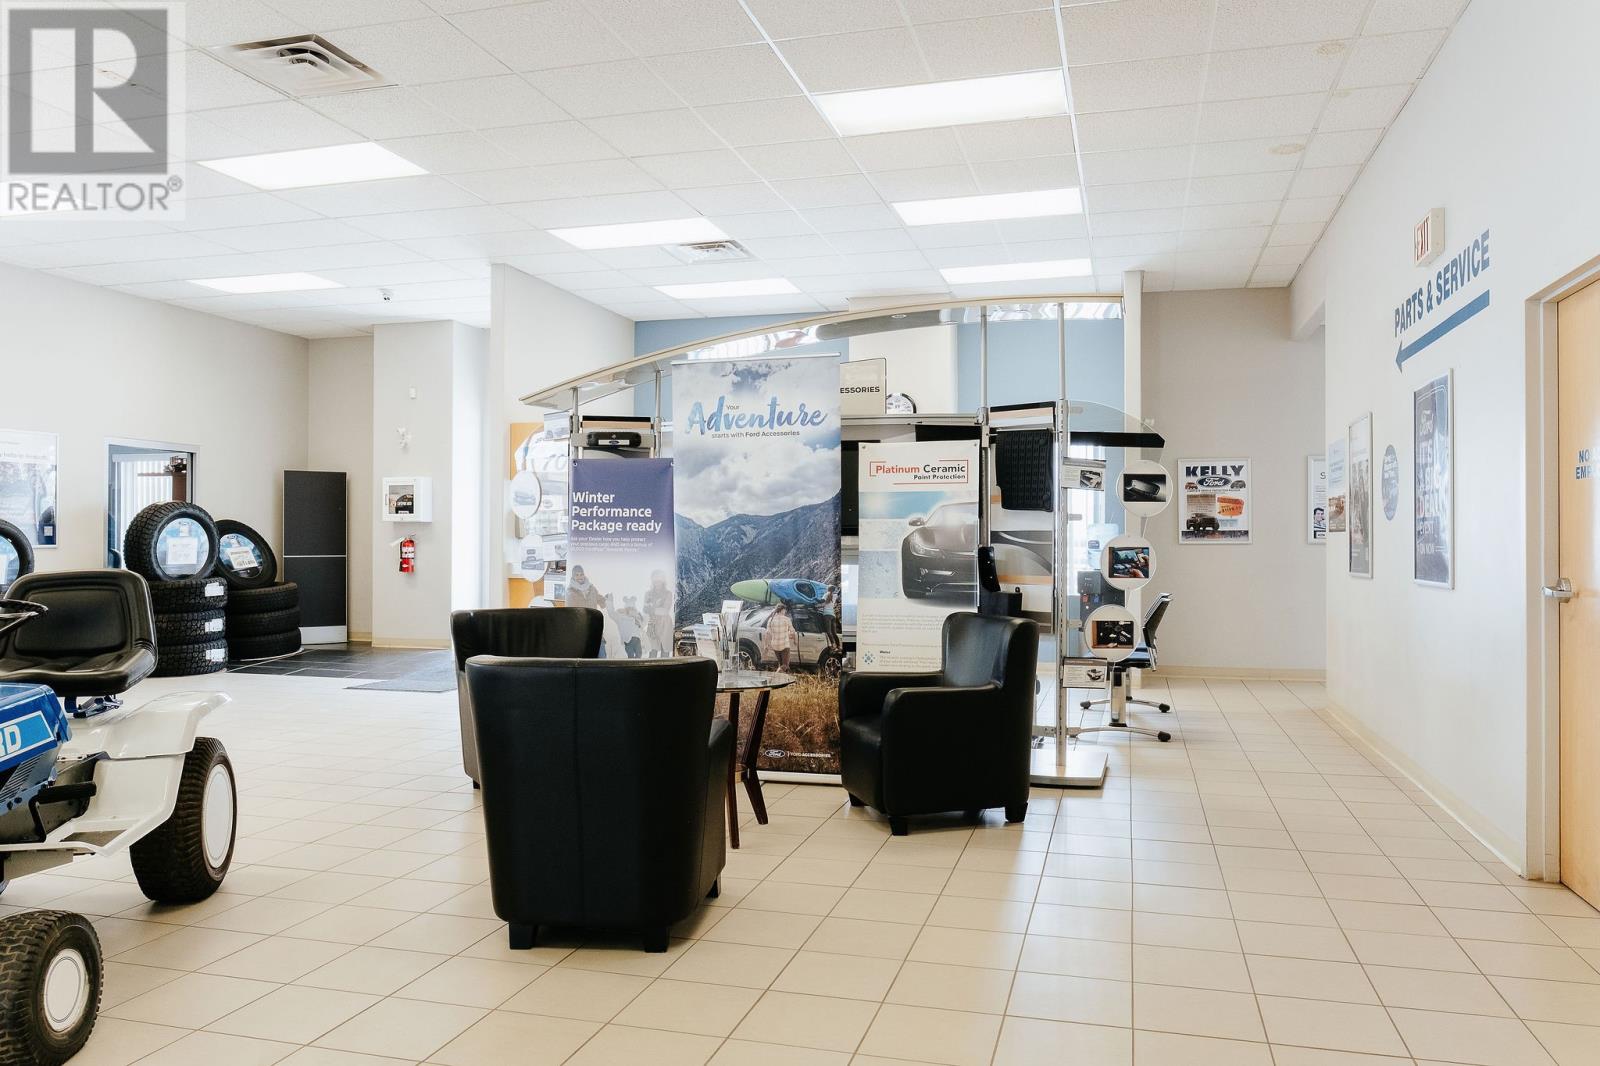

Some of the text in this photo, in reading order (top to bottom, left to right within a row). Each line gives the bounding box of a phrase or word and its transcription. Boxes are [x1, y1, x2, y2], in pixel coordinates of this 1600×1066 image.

[1416, 216, 1430, 261] EXIT
[1394, 228, 1490, 338] PARTS & SERVICE
[685, 395, 829, 436] Adventure
[875, 464, 966, 475] Platinum Ceramic
[1185, 465, 1244, 477] KELLY
[572, 491, 615, 503] Winter
[571, 505, 652, 517] Performance
[571, 520, 662, 533] Package ready
